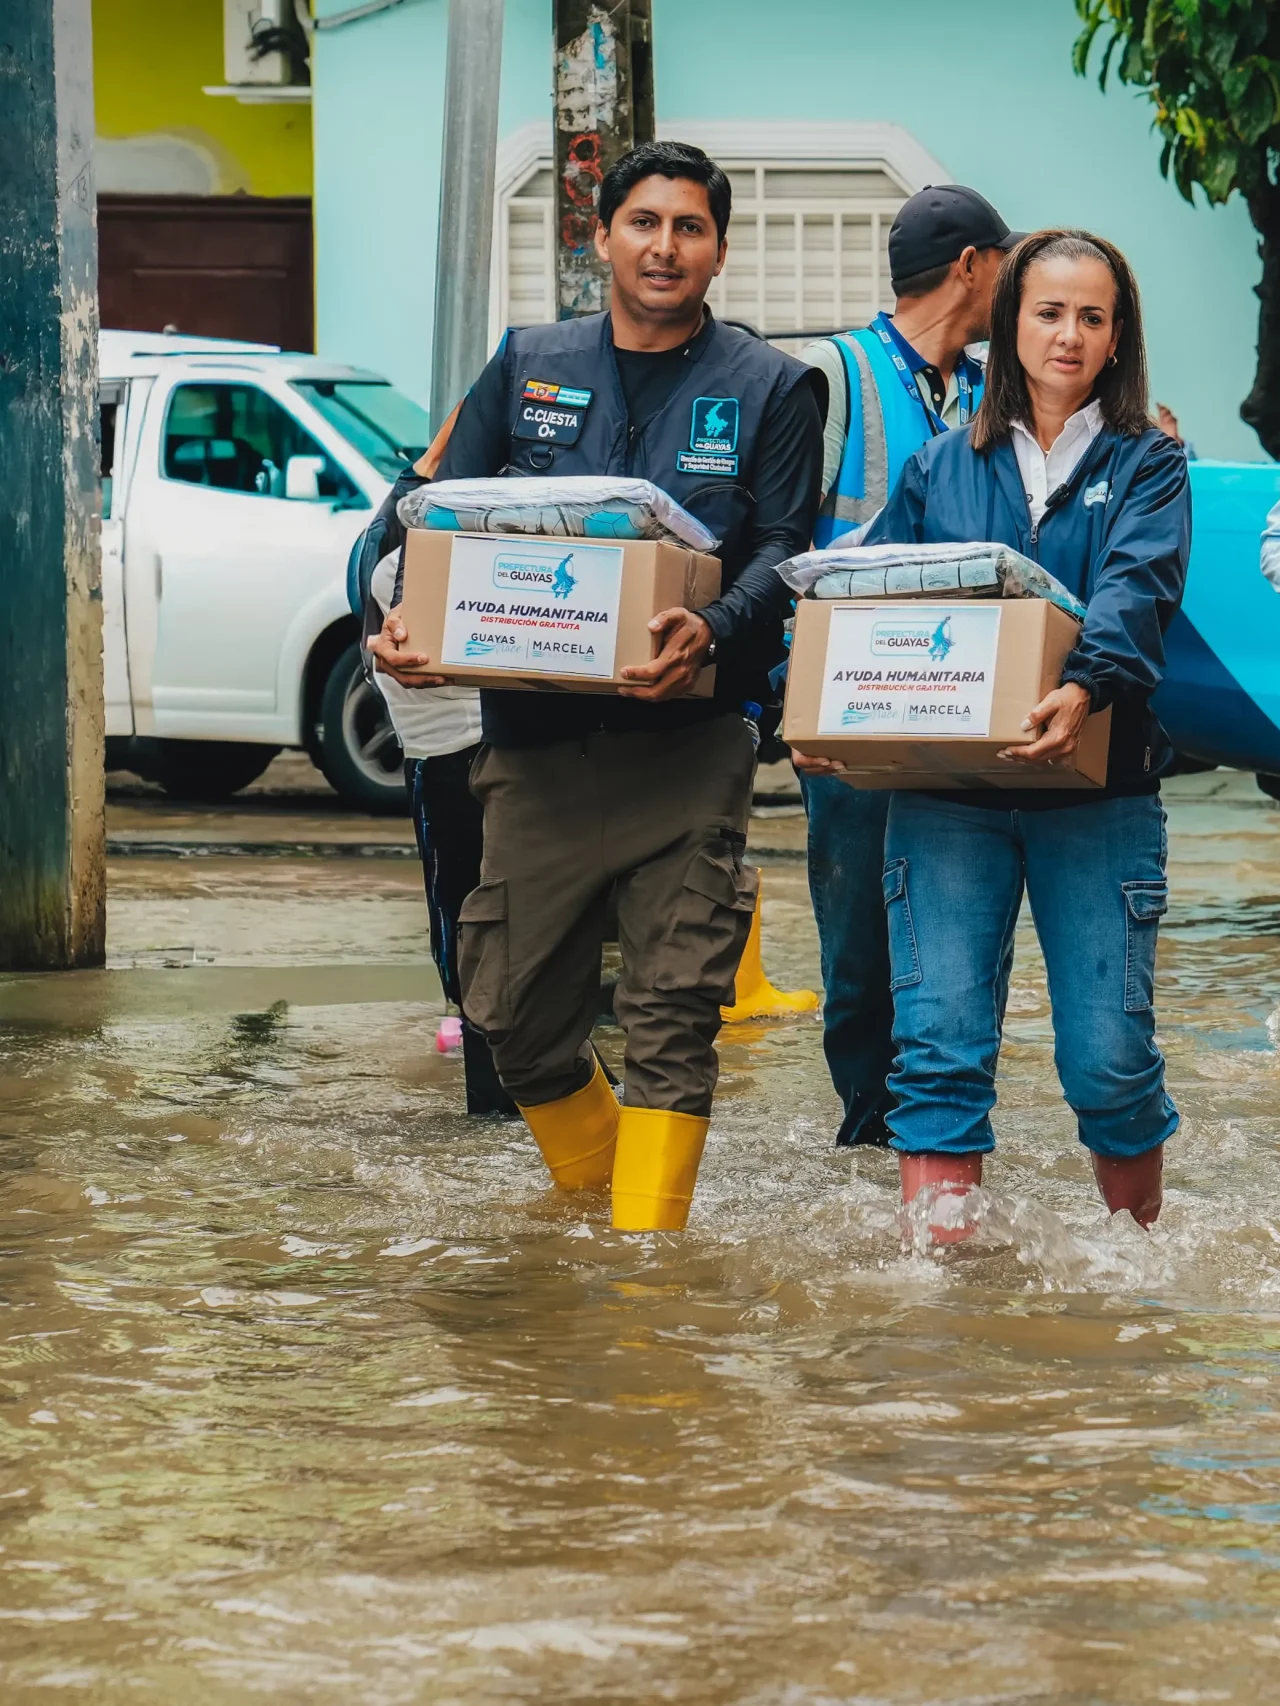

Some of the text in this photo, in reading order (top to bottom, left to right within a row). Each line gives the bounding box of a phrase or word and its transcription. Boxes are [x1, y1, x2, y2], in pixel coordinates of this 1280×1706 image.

[523, 407, 578, 428] C.CUESTA
[704, 442, 731, 450] GUAYAS
[498, 562, 553, 573] PREFECTURA
[510, 571, 553, 583] GUAYAS
[456, 600, 608, 623] AYUDA HUMANITARIA
[480, 616, 580, 631] DISTRIBUCIÓN GRATUITA
[471, 633, 516, 644] GUAYAS
[887, 638, 930, 647] GUAYAS
[532, 640, 595, 655] MARCELA
[833, 671, 985, 682] AYUDA HUMANITARIA
[916, 684, 957, 692] GRATUITA
[847, 702, 892, 711] GUAYAS
[909, 705, 971, 715] MARCELA
